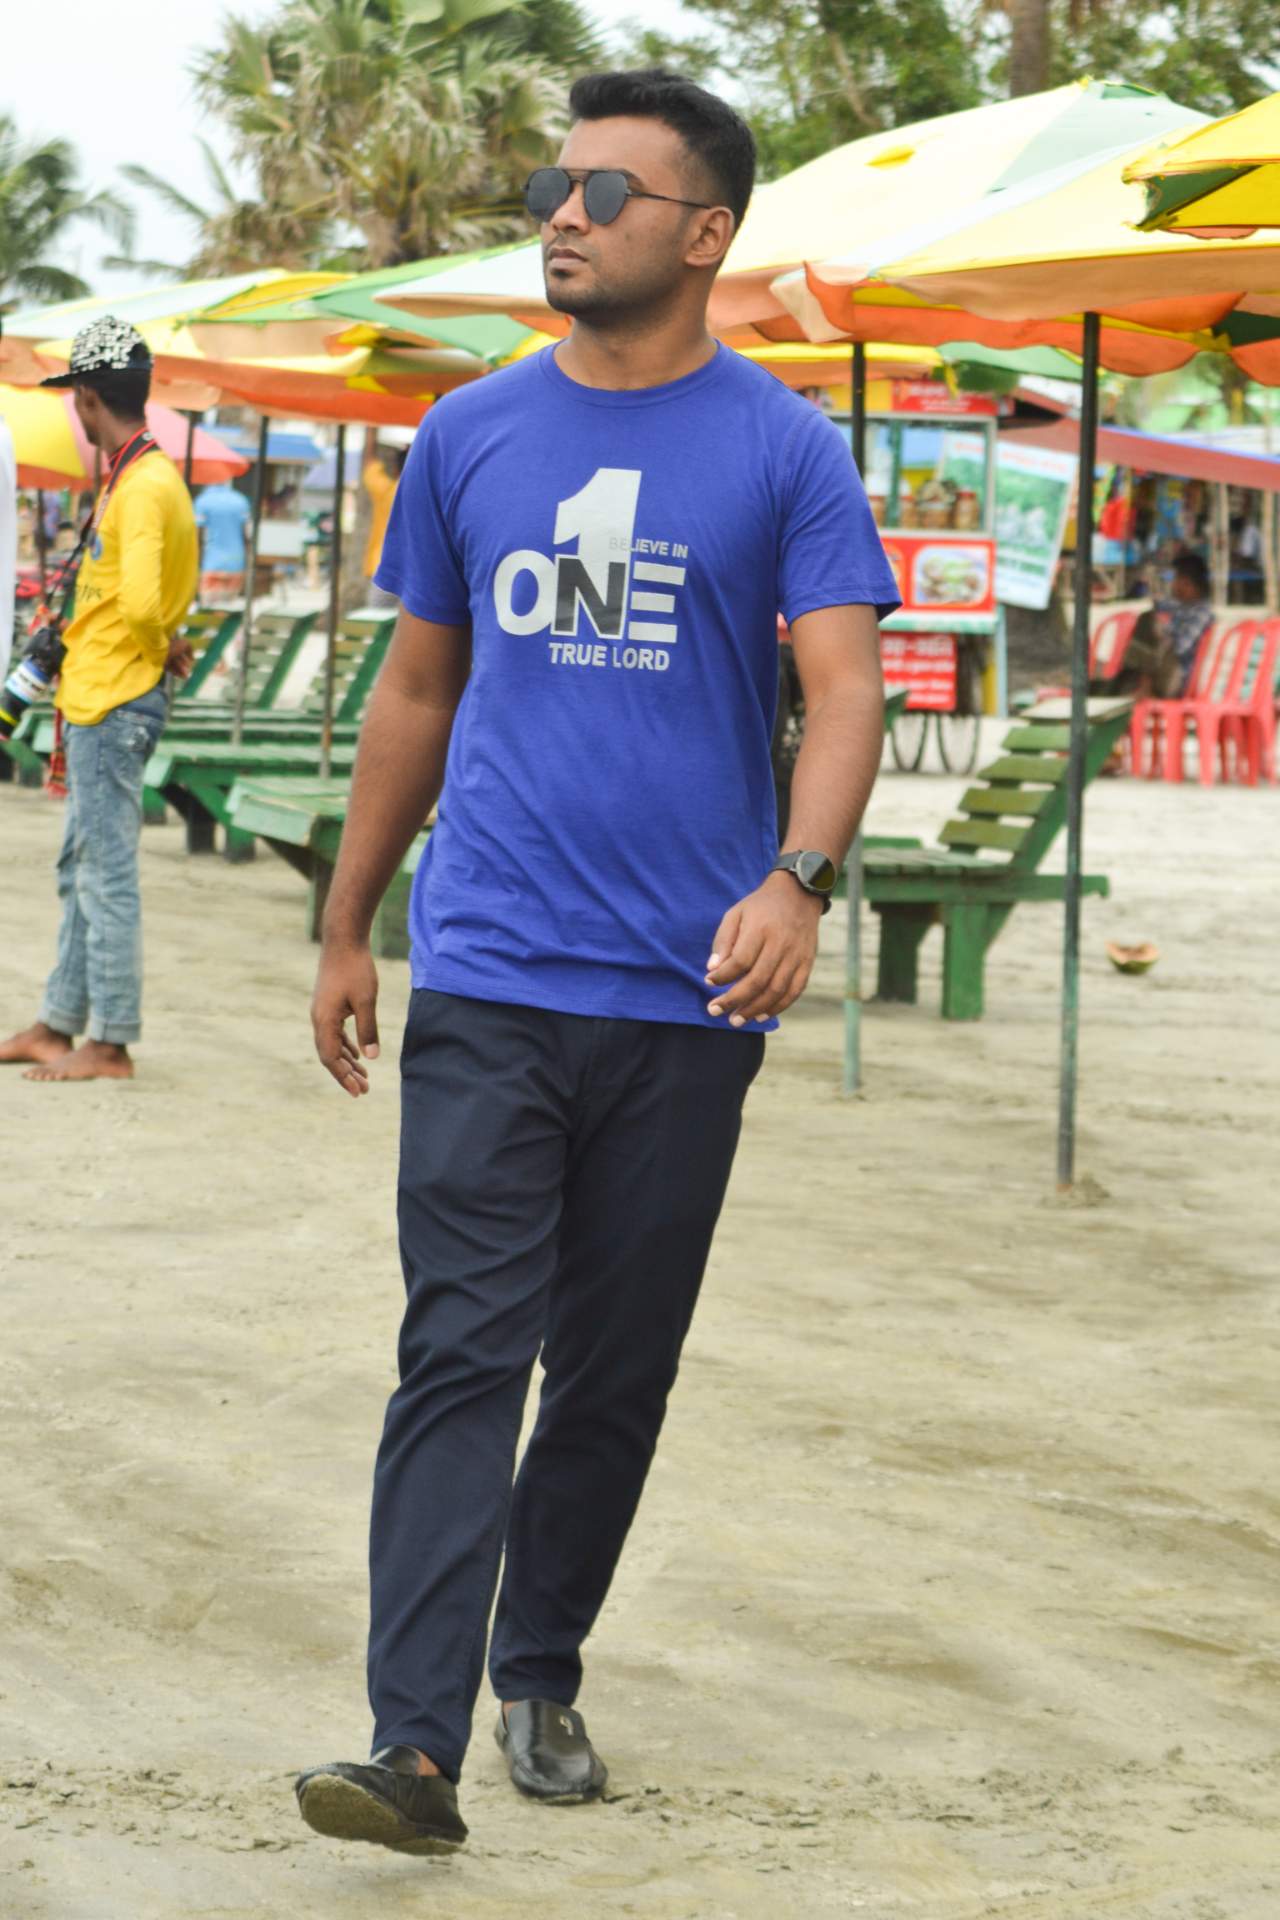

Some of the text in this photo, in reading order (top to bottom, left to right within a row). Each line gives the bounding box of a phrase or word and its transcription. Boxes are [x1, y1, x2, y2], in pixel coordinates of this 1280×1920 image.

[672, 543, 689, 559] IN
[493, 549, 687, 644] ONE
[549, 642, 670, 671] TRUE LORD
